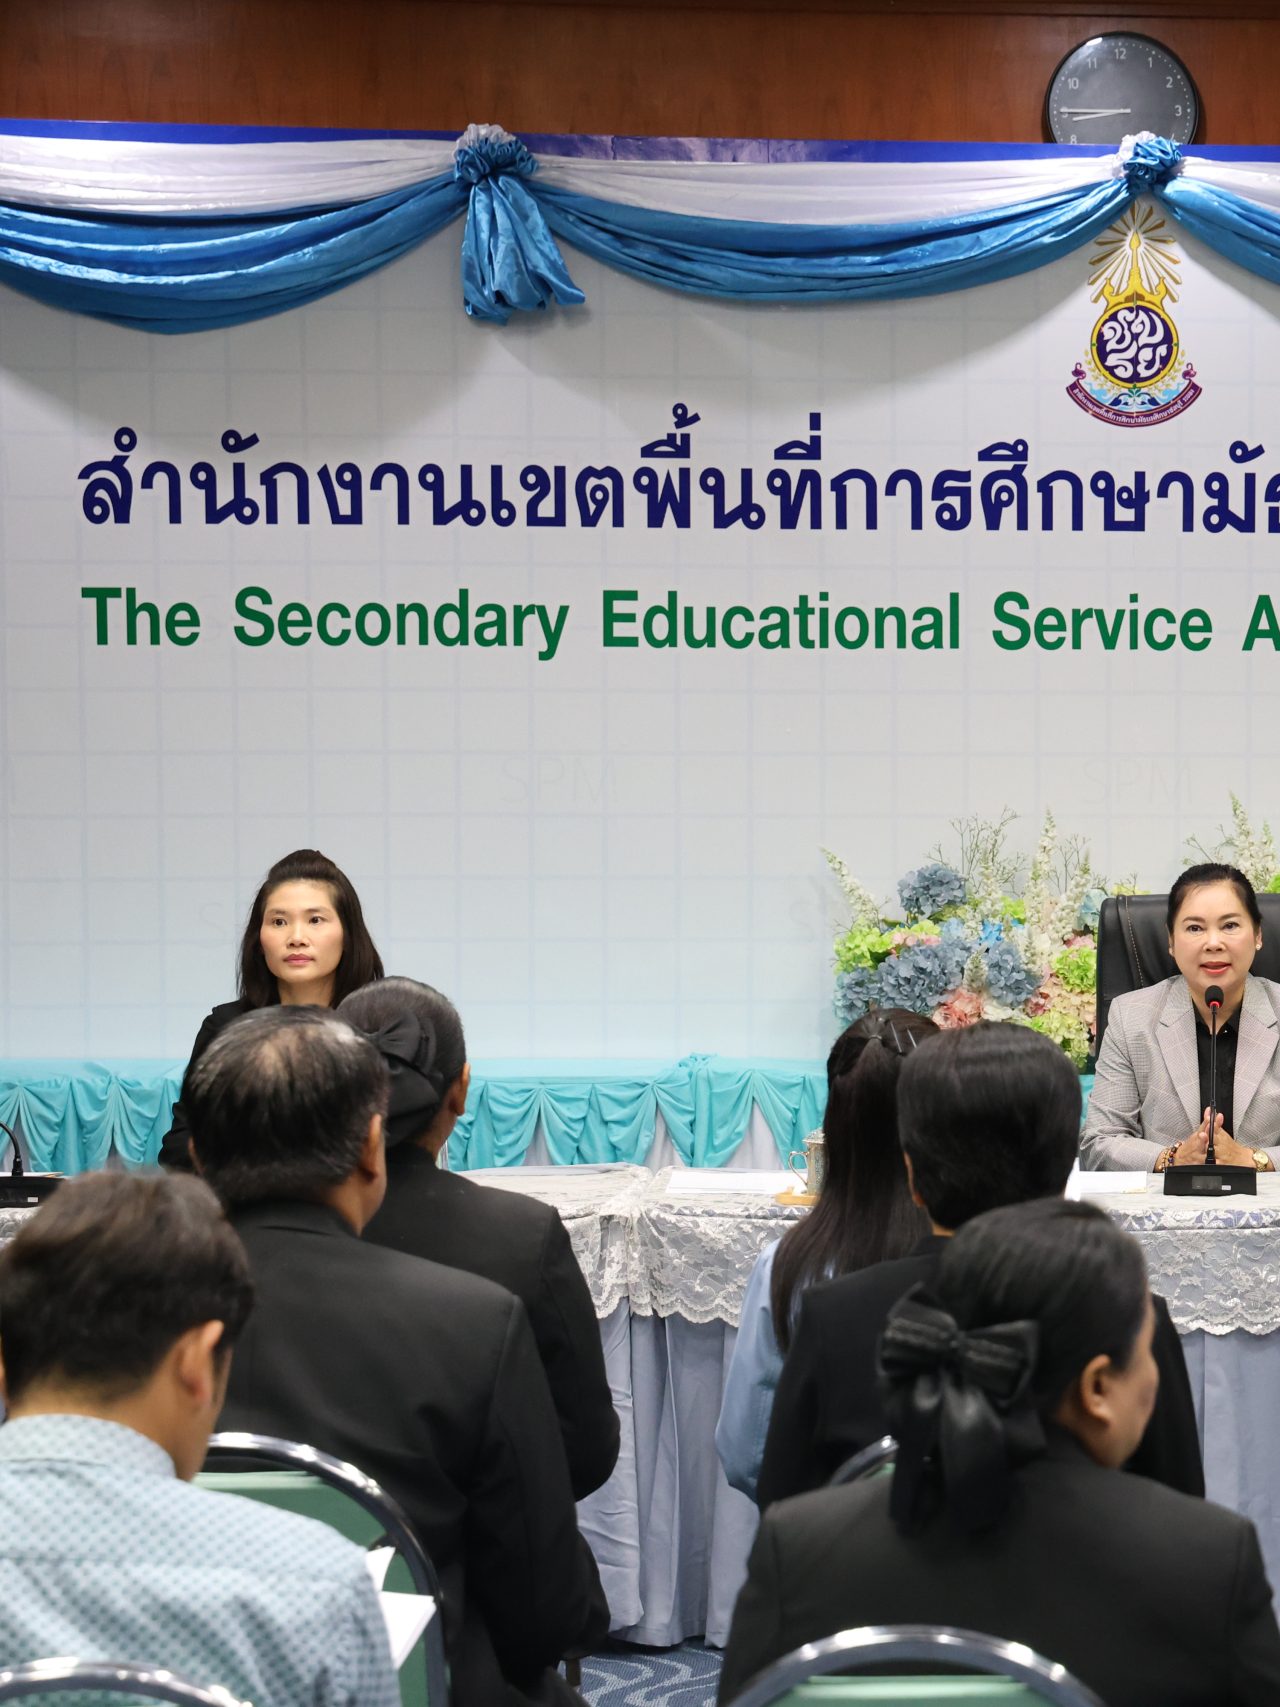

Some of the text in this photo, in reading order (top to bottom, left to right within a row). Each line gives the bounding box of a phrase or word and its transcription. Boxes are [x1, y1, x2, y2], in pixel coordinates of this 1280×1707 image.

[1115, 48, 1127, 60] 12
[1087, 58, 1098, 69] 11
[1067, 77, 1079, 90] 10
[1166, 76, 1173, 88] 2
[1174, 105, 1182, 117] 3
[81, 587, 200, 646] The
[233, 586, 570, 661] Secondary
[602, 589, 960, 650] Educational
[991, 591, 1213, 652] Service
